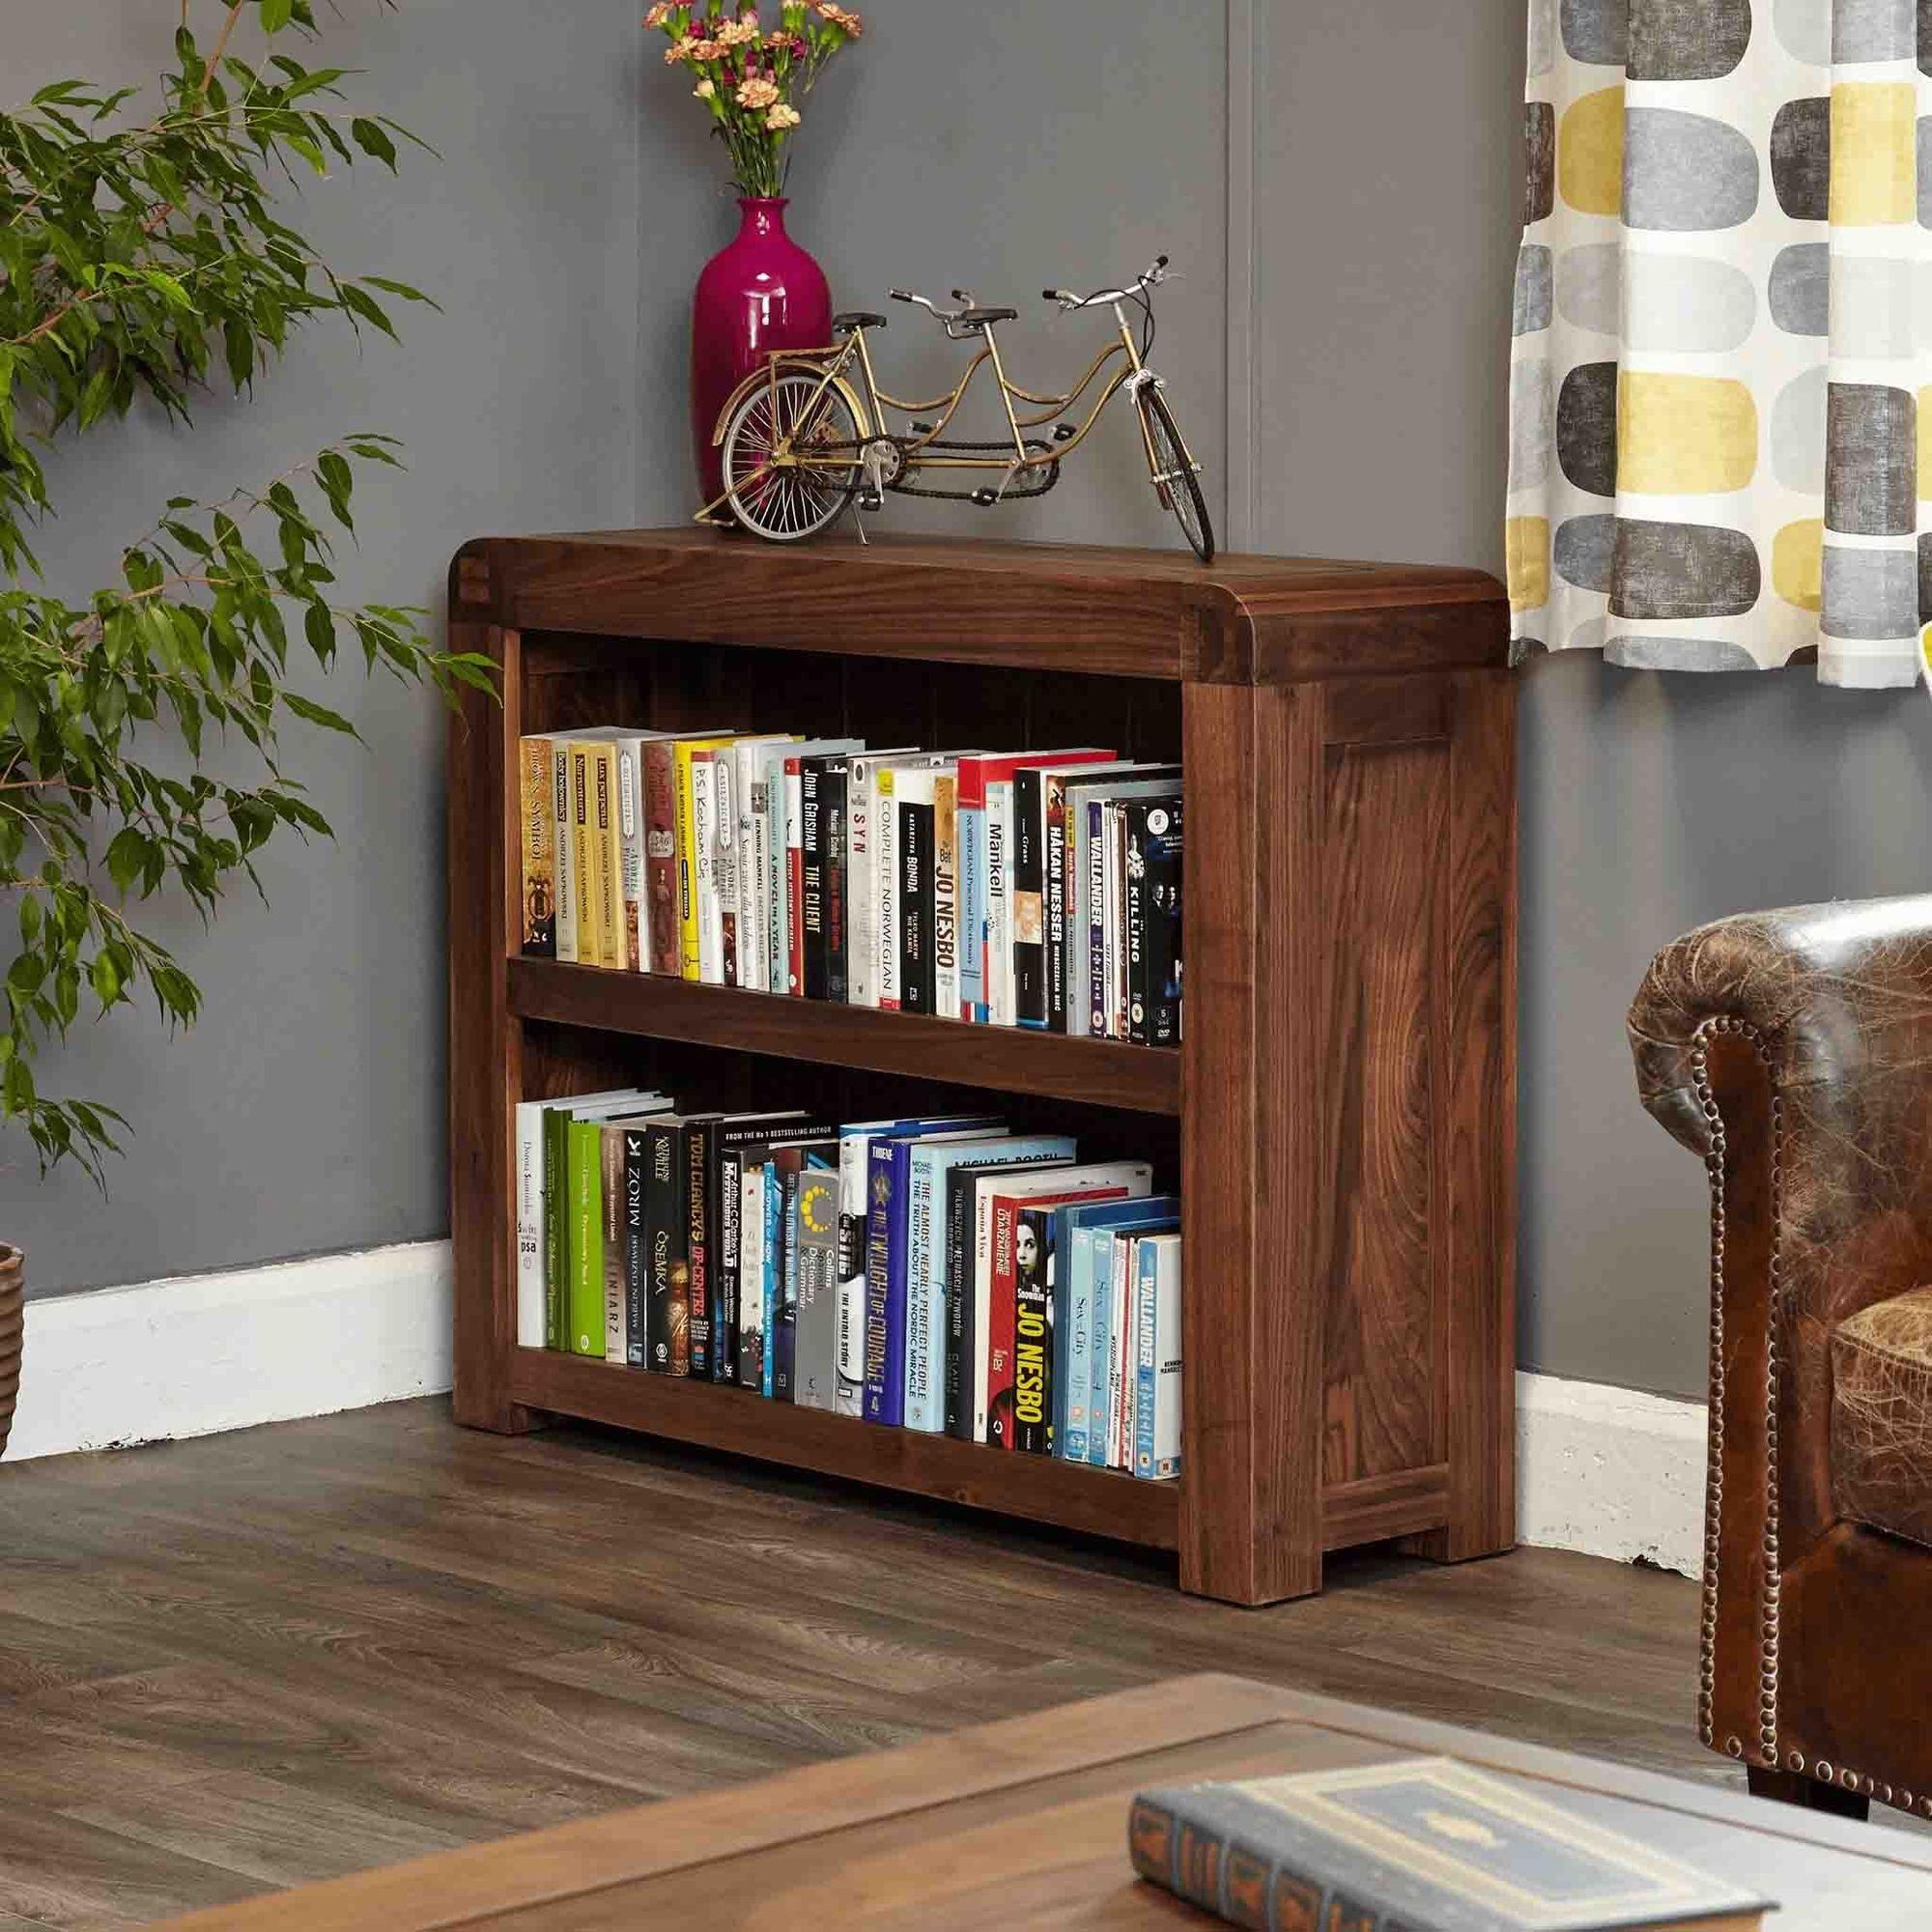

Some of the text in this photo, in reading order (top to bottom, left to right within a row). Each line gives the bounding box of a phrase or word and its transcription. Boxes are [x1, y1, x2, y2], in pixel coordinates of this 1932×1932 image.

[696, 797, 707, 854] Kocham
[804, 769, 819, 852] JOHN GRISHAM
[853, 813, 867, 853] SYN
[906, 856, 919, 894] BONDA
[989, 823, 1004, 897] Mankell
[1022, 836, 1031, 865] Grass
[805, 866, 820, 933] THE CLIENT
[881, 801, 893, 990] COMPLETE NORWEGIAN
[935, 866, 954, 895] JO
[1049, 827, 1065, 942] HÅKAN NESSER
[1090, 837, 1103, 926] WALLANDER
[935, 899, 955, 968] NESBO
[1130, 886, 1140, 963] KILLING
[690, 1134, 703, 1166] TOM
[771, 1128, 809, 1137] BESTSELLING
[810, 1125, 832, 1135] AUTHOR
[654, 1137, 665, 1179] NEVILLE
[729, 1180, 738, 1208] Arthur
[765, 1188, 774, 1226] POWER
[912, 1179, 921, 1200] THE
[729, 1218, 738, 1254] Clarke's
[873, 1208, 887, 1229] THE
[912, 1203, 921, 1237] TRUTH
[996, 1208, 1007, 1275] UJARZMIENIE
[521, 1242, 536, 1253] psa
[724, 1228, 737, 1267] WORLD
[816, 1246, 826, 1291] Spanish
[825, 1248, 835, 1288] Collins
[869, 1232, 889, 1300] TWILIGHT
[911, 1239, 921, 1277] ABOUT
[692, 1246, 705, 1316] OP-CENTRE
[798, 1255, 809, 1309] Grammar
[807, 1245, 818, 1304] Dictionary
[918, 1180, 930, 1399] THE ALMOST NEARLY PERFECT PEOPLE
[840, 1293, 850, 1368] THE UNTOLD STORY
[870, 1300, 884, 1315] OF
[910, 1302, 919, 1346] NORDIC
[1072, 1298, 1087, 1355] Sex City
[1140, 1276, 1155, 1367] WALLANDER
[867, 1316, 887, 1381] COURAGE
[1015, 1303, 1045, 1423] JO NESBO
[909, 1349, 918, 1398] MIRACLE
